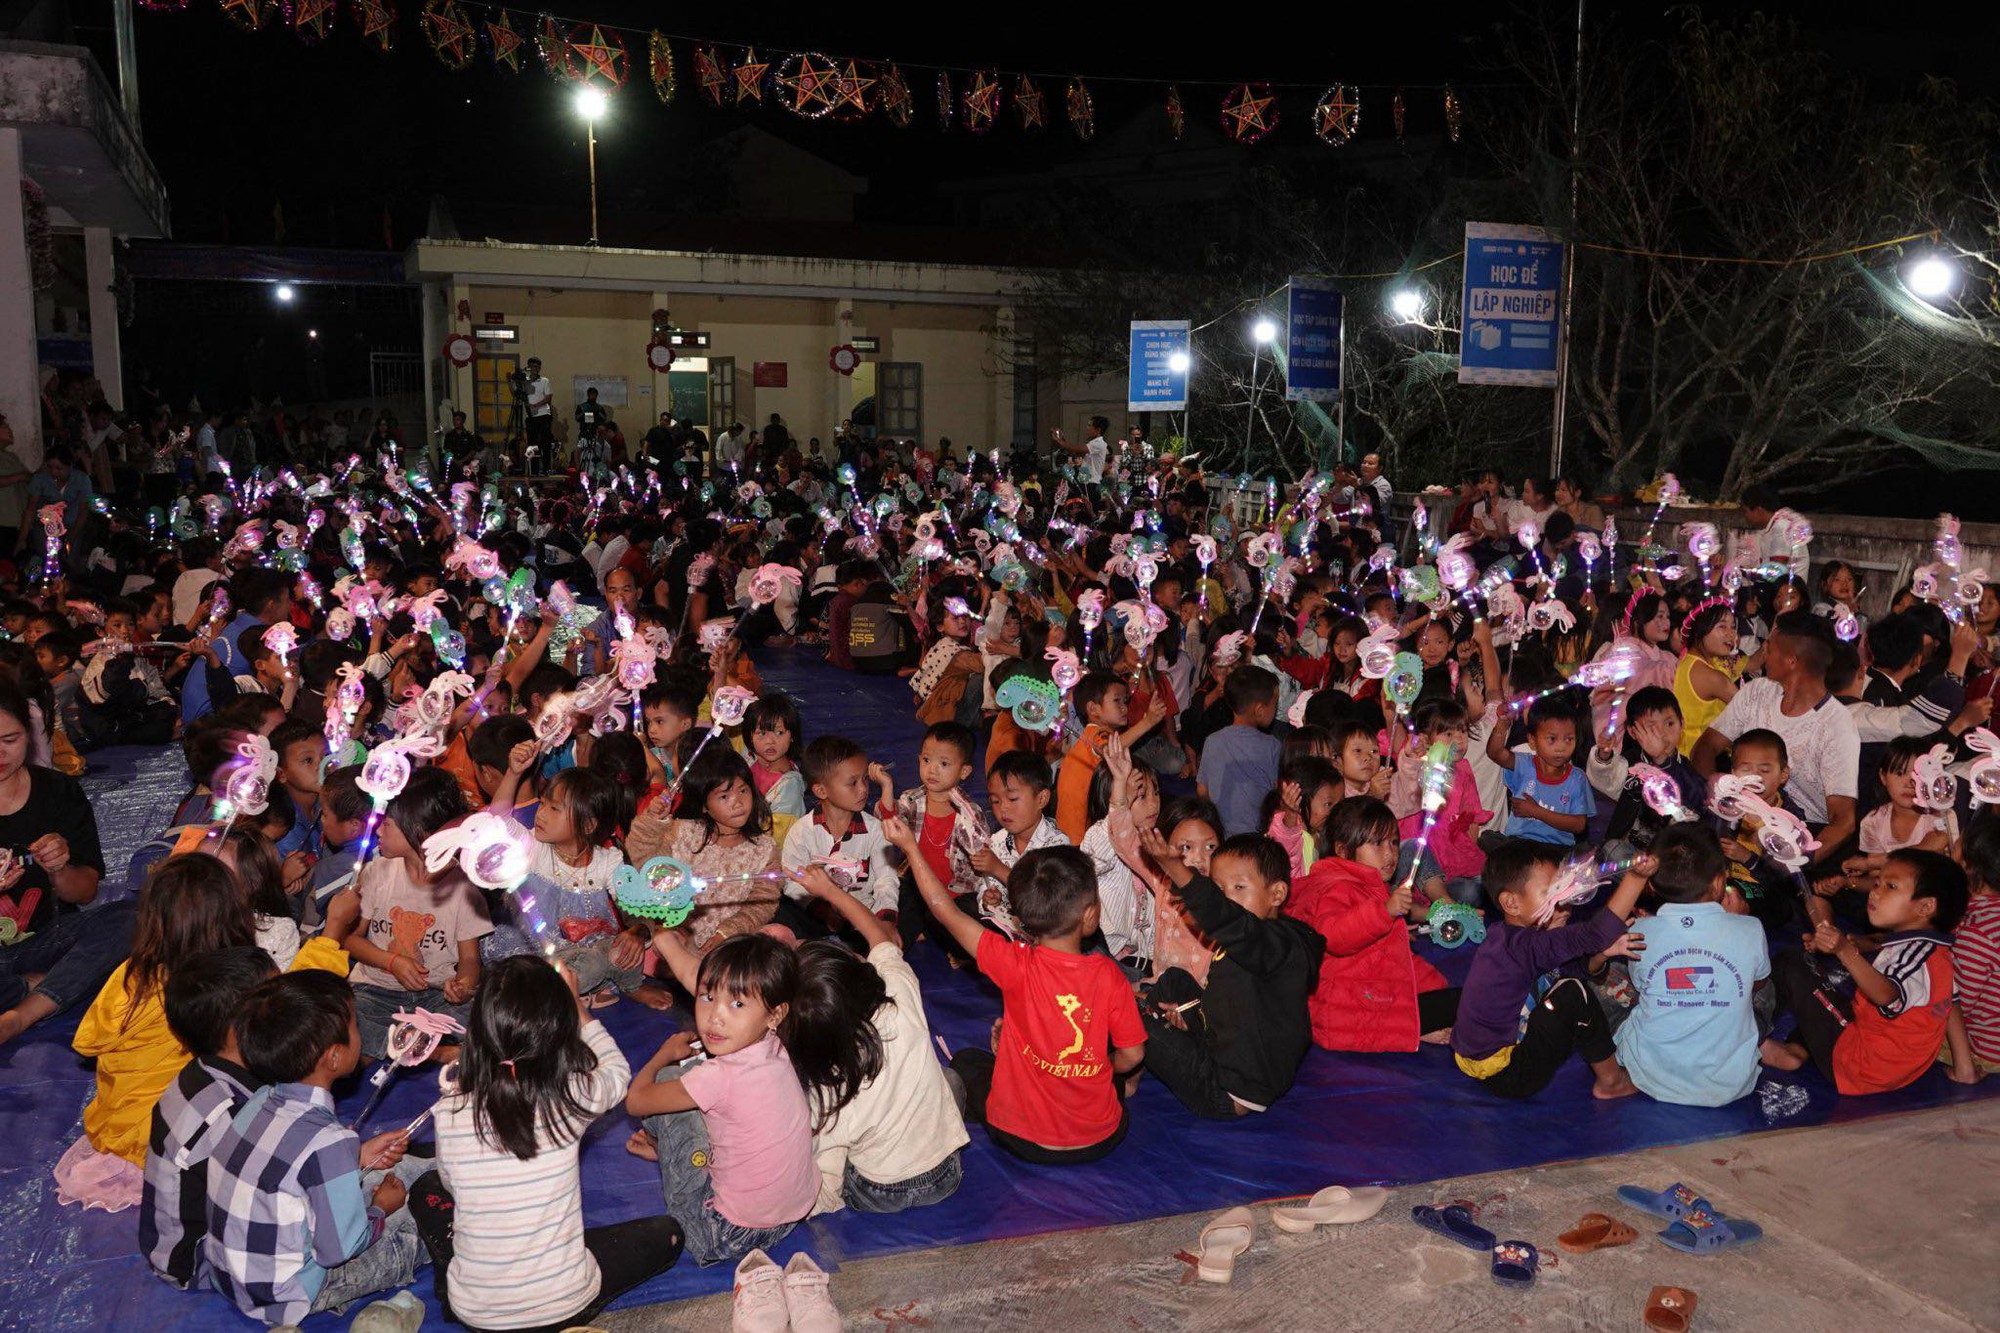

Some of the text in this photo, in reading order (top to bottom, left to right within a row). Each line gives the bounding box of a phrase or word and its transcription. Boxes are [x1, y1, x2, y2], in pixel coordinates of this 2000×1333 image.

[1490, 259, 1539, 287] HỌC ĐỂ
[1473, 291, 1552, 318] LẬP NGHIỆP
